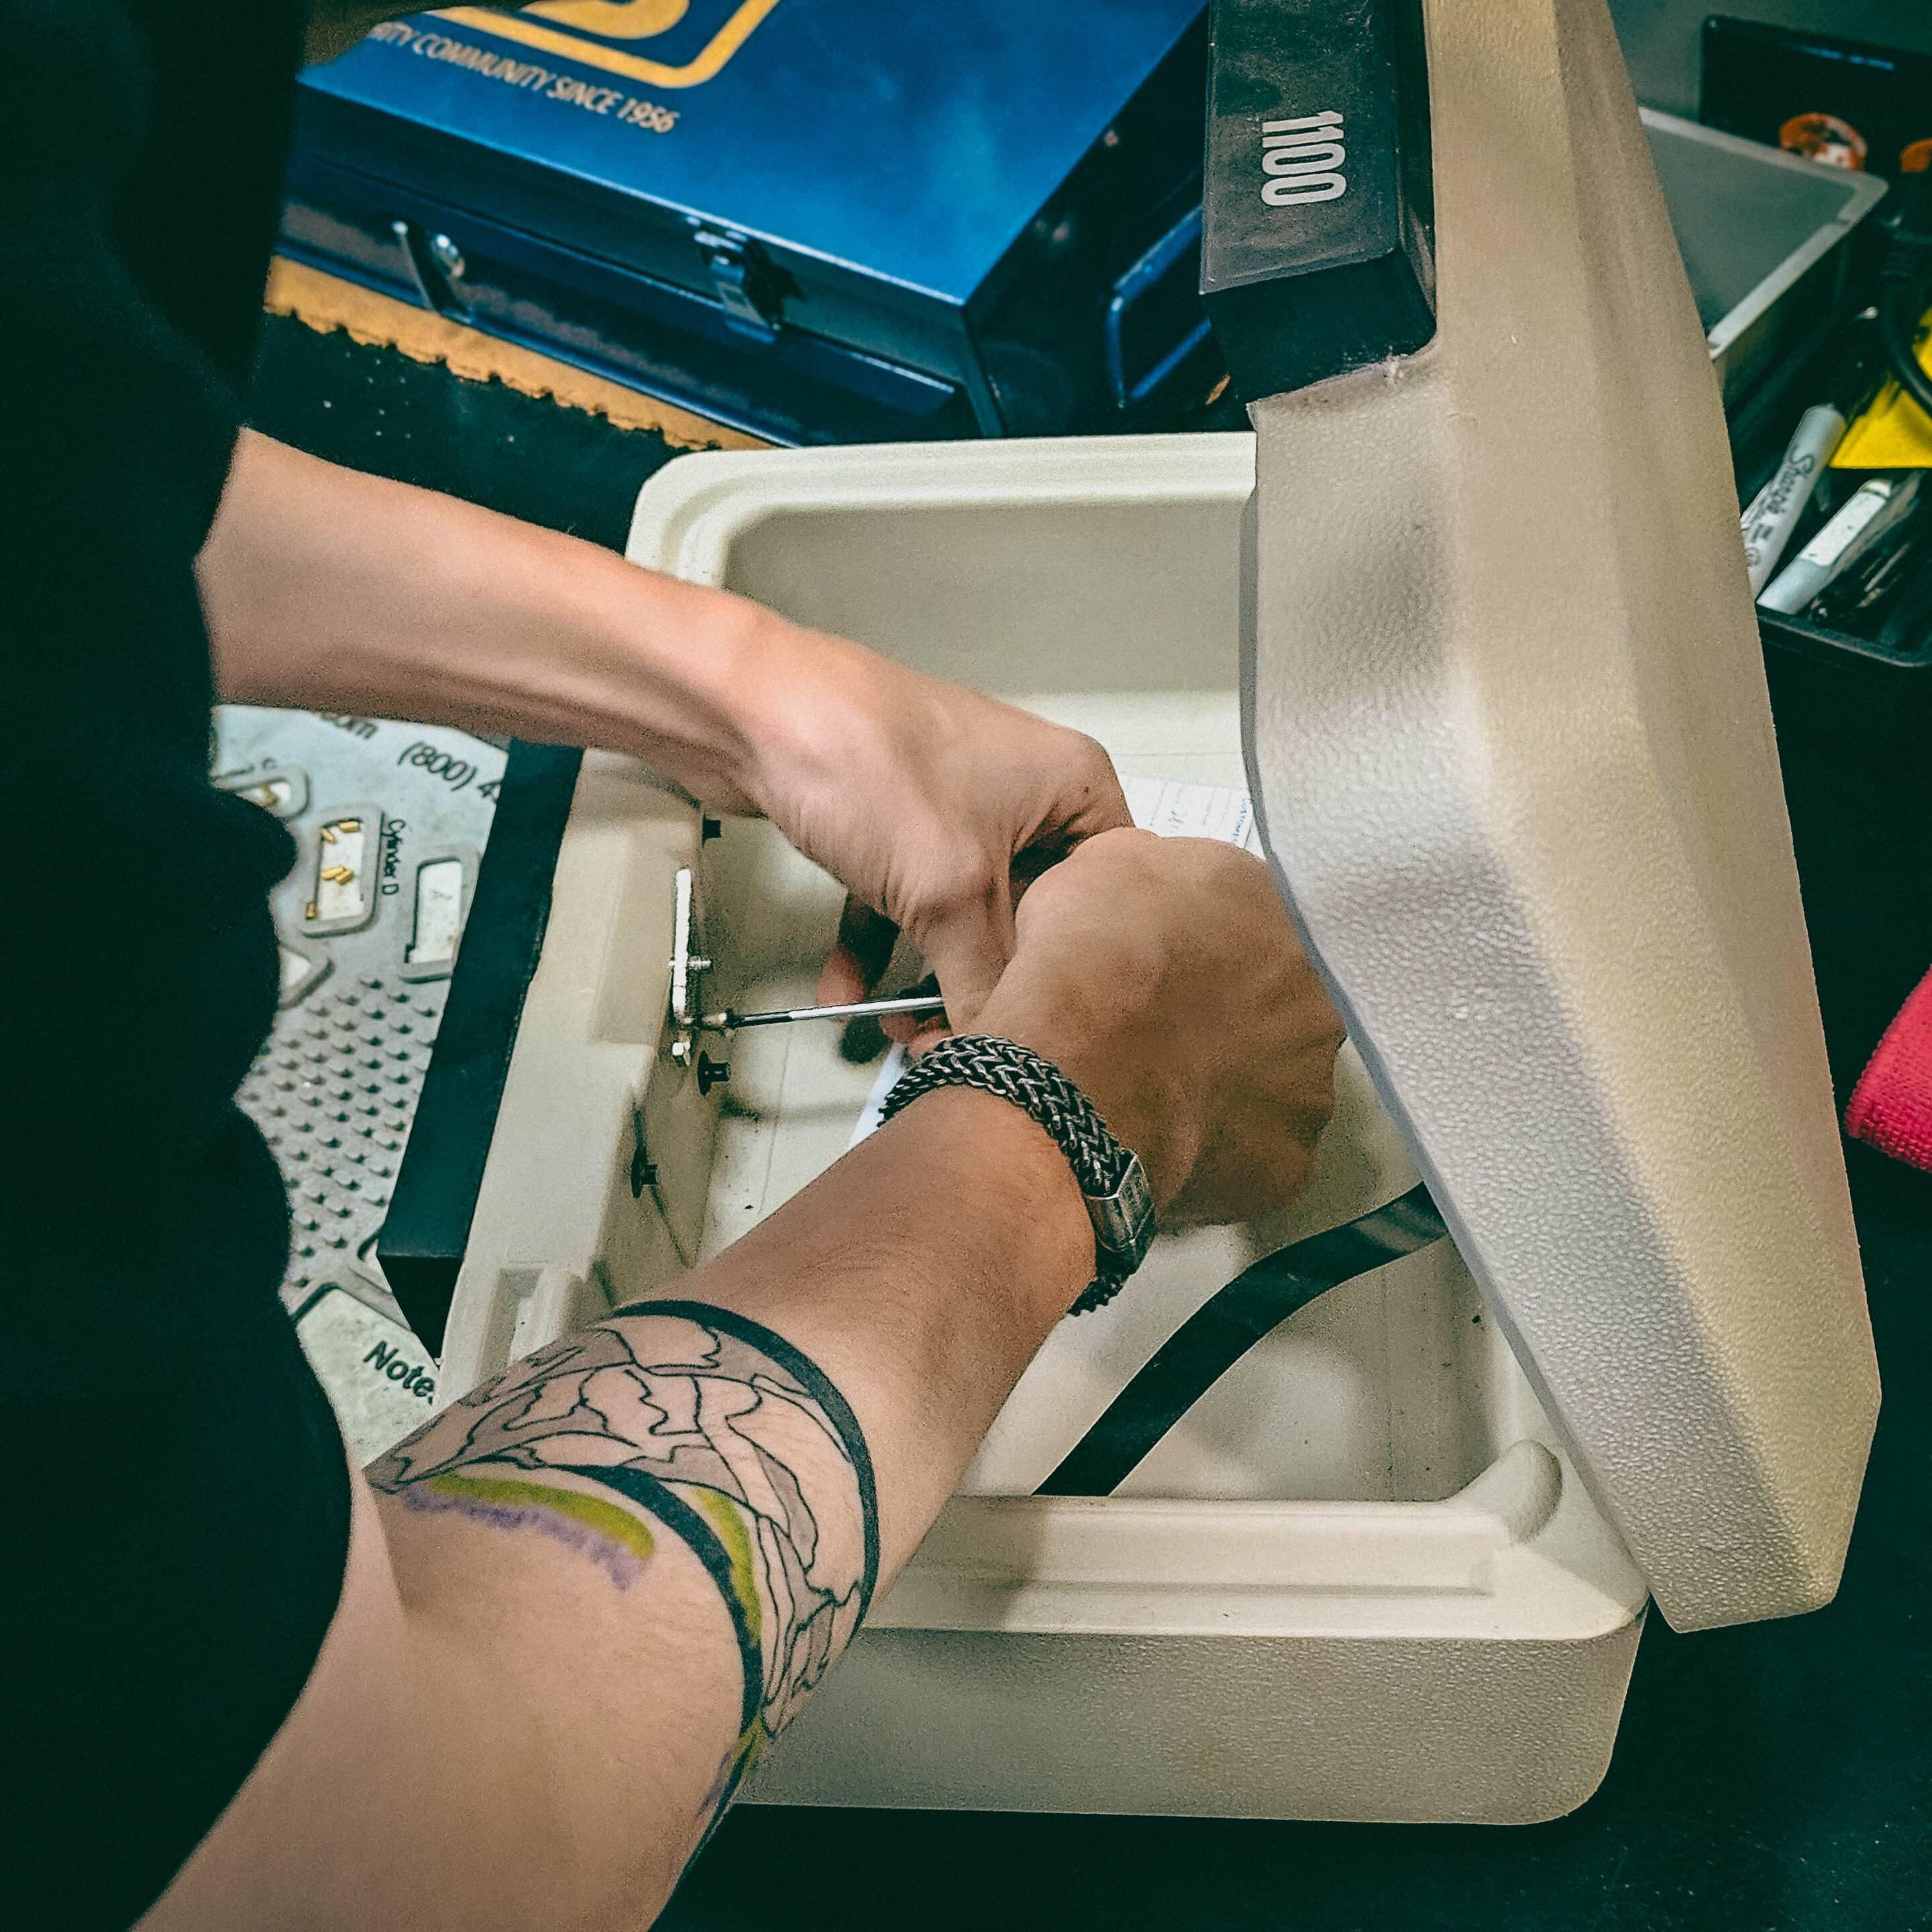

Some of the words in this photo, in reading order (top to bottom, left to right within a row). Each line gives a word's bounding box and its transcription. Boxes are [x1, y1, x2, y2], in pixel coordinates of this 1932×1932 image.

[412, 32, 557, 91] COMMUNITY
[546, 76, 622, 115] SINCE
[616, 97, 680, 133] 1956
[1261, 110, 1346, 207] 1100
[397, 741, 478, 792] (800)
[380, 819, 406, 879] Cylinder
[381, 883, 399, 895] D
